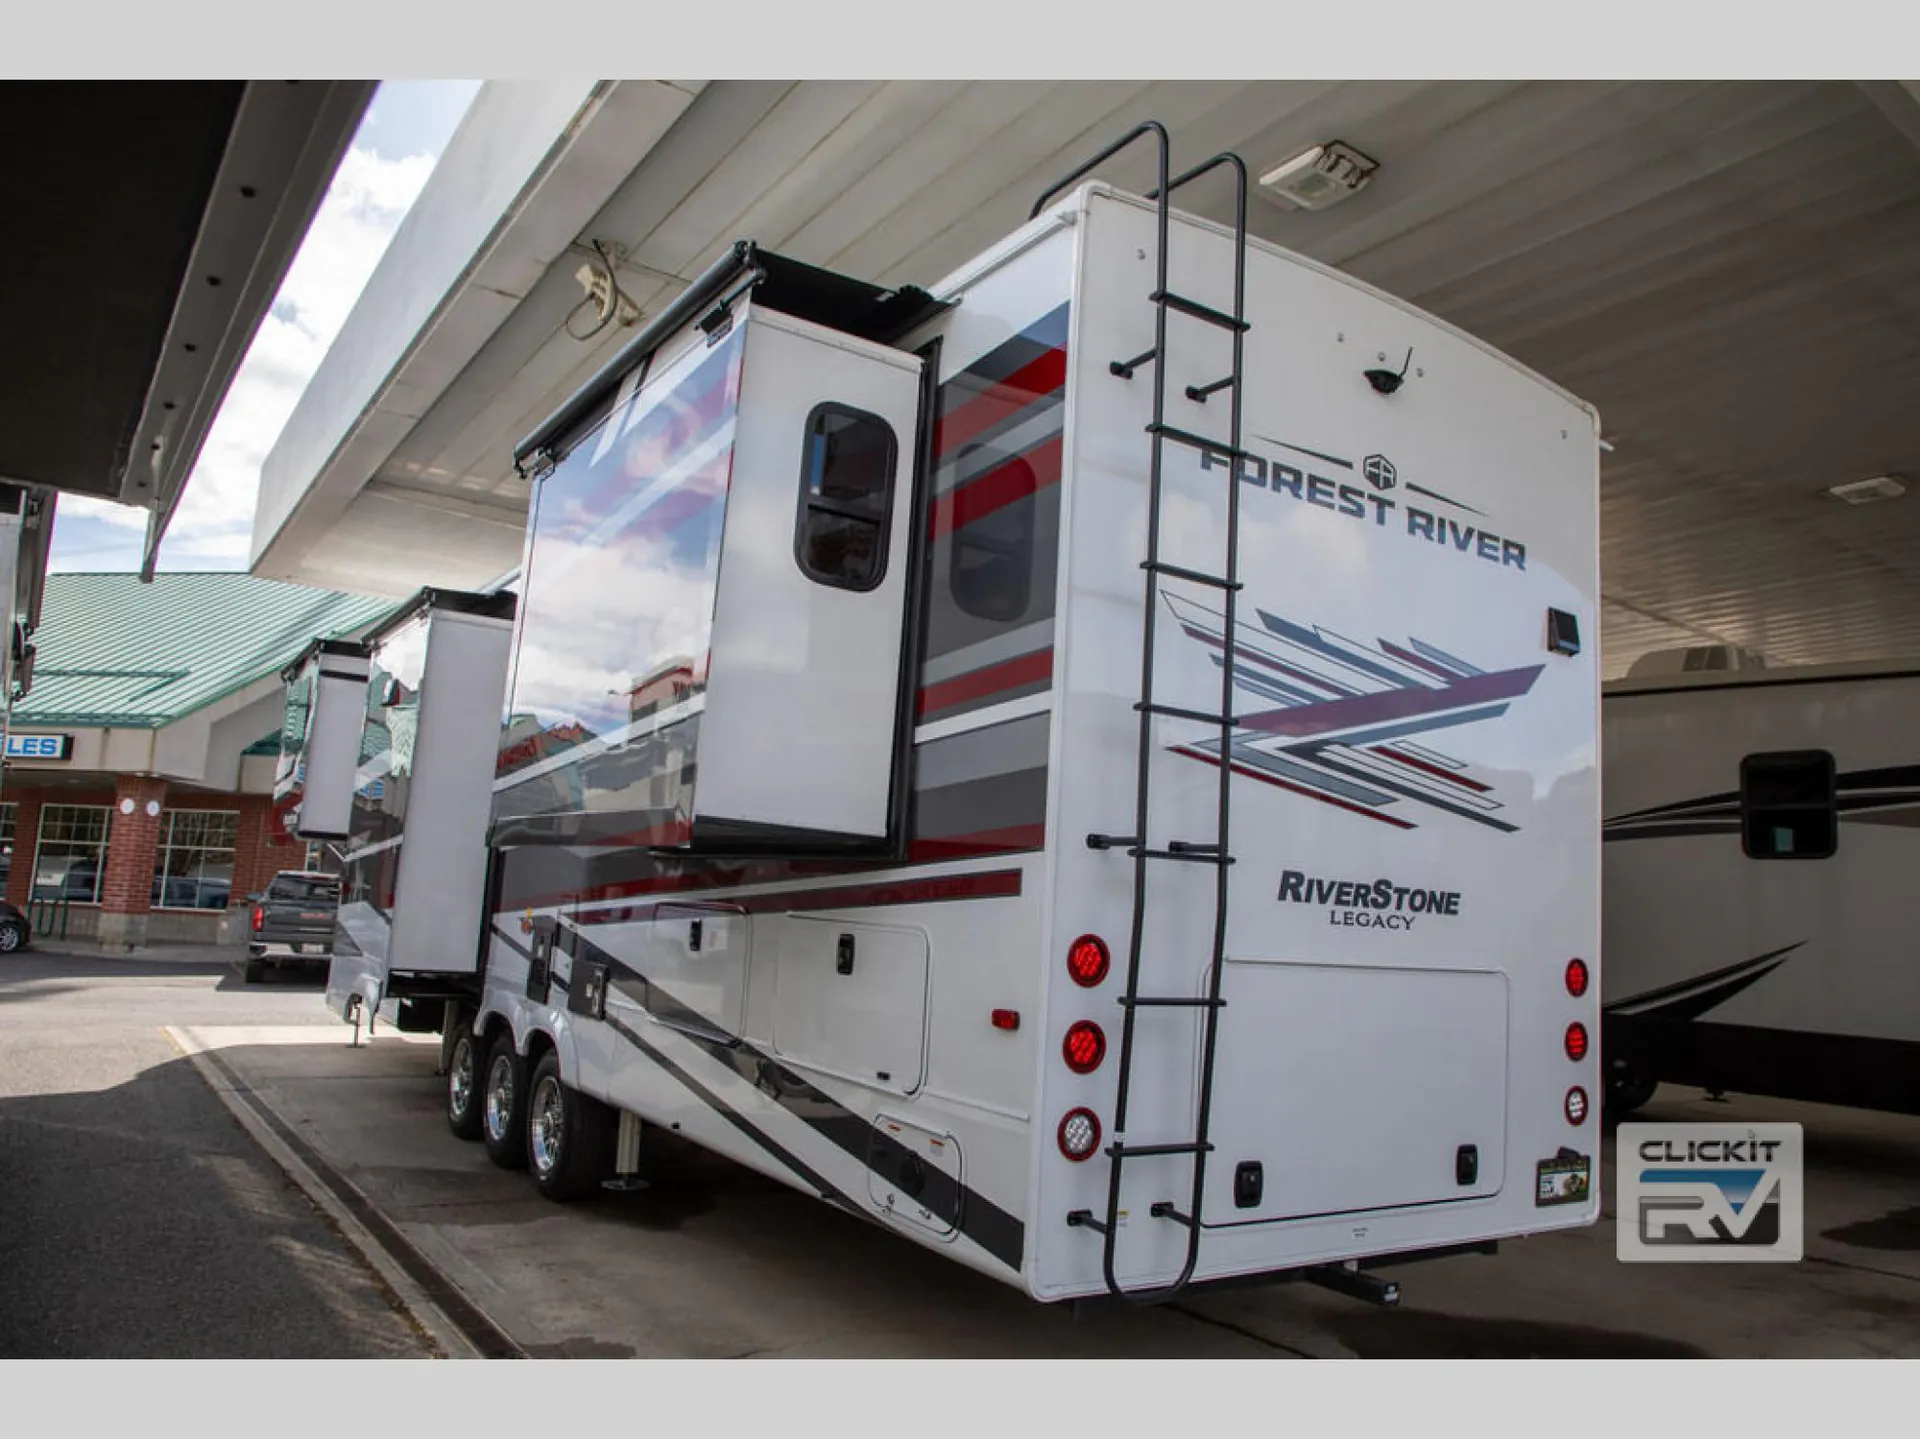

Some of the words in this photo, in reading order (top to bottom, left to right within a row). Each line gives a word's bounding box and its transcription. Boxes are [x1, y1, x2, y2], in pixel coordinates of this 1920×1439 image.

[1201, 447, 1395, 526] FOREST
[1406, 506, 1526, 570] RIVER
[1329, 910, 1416, 931] LEGACY
